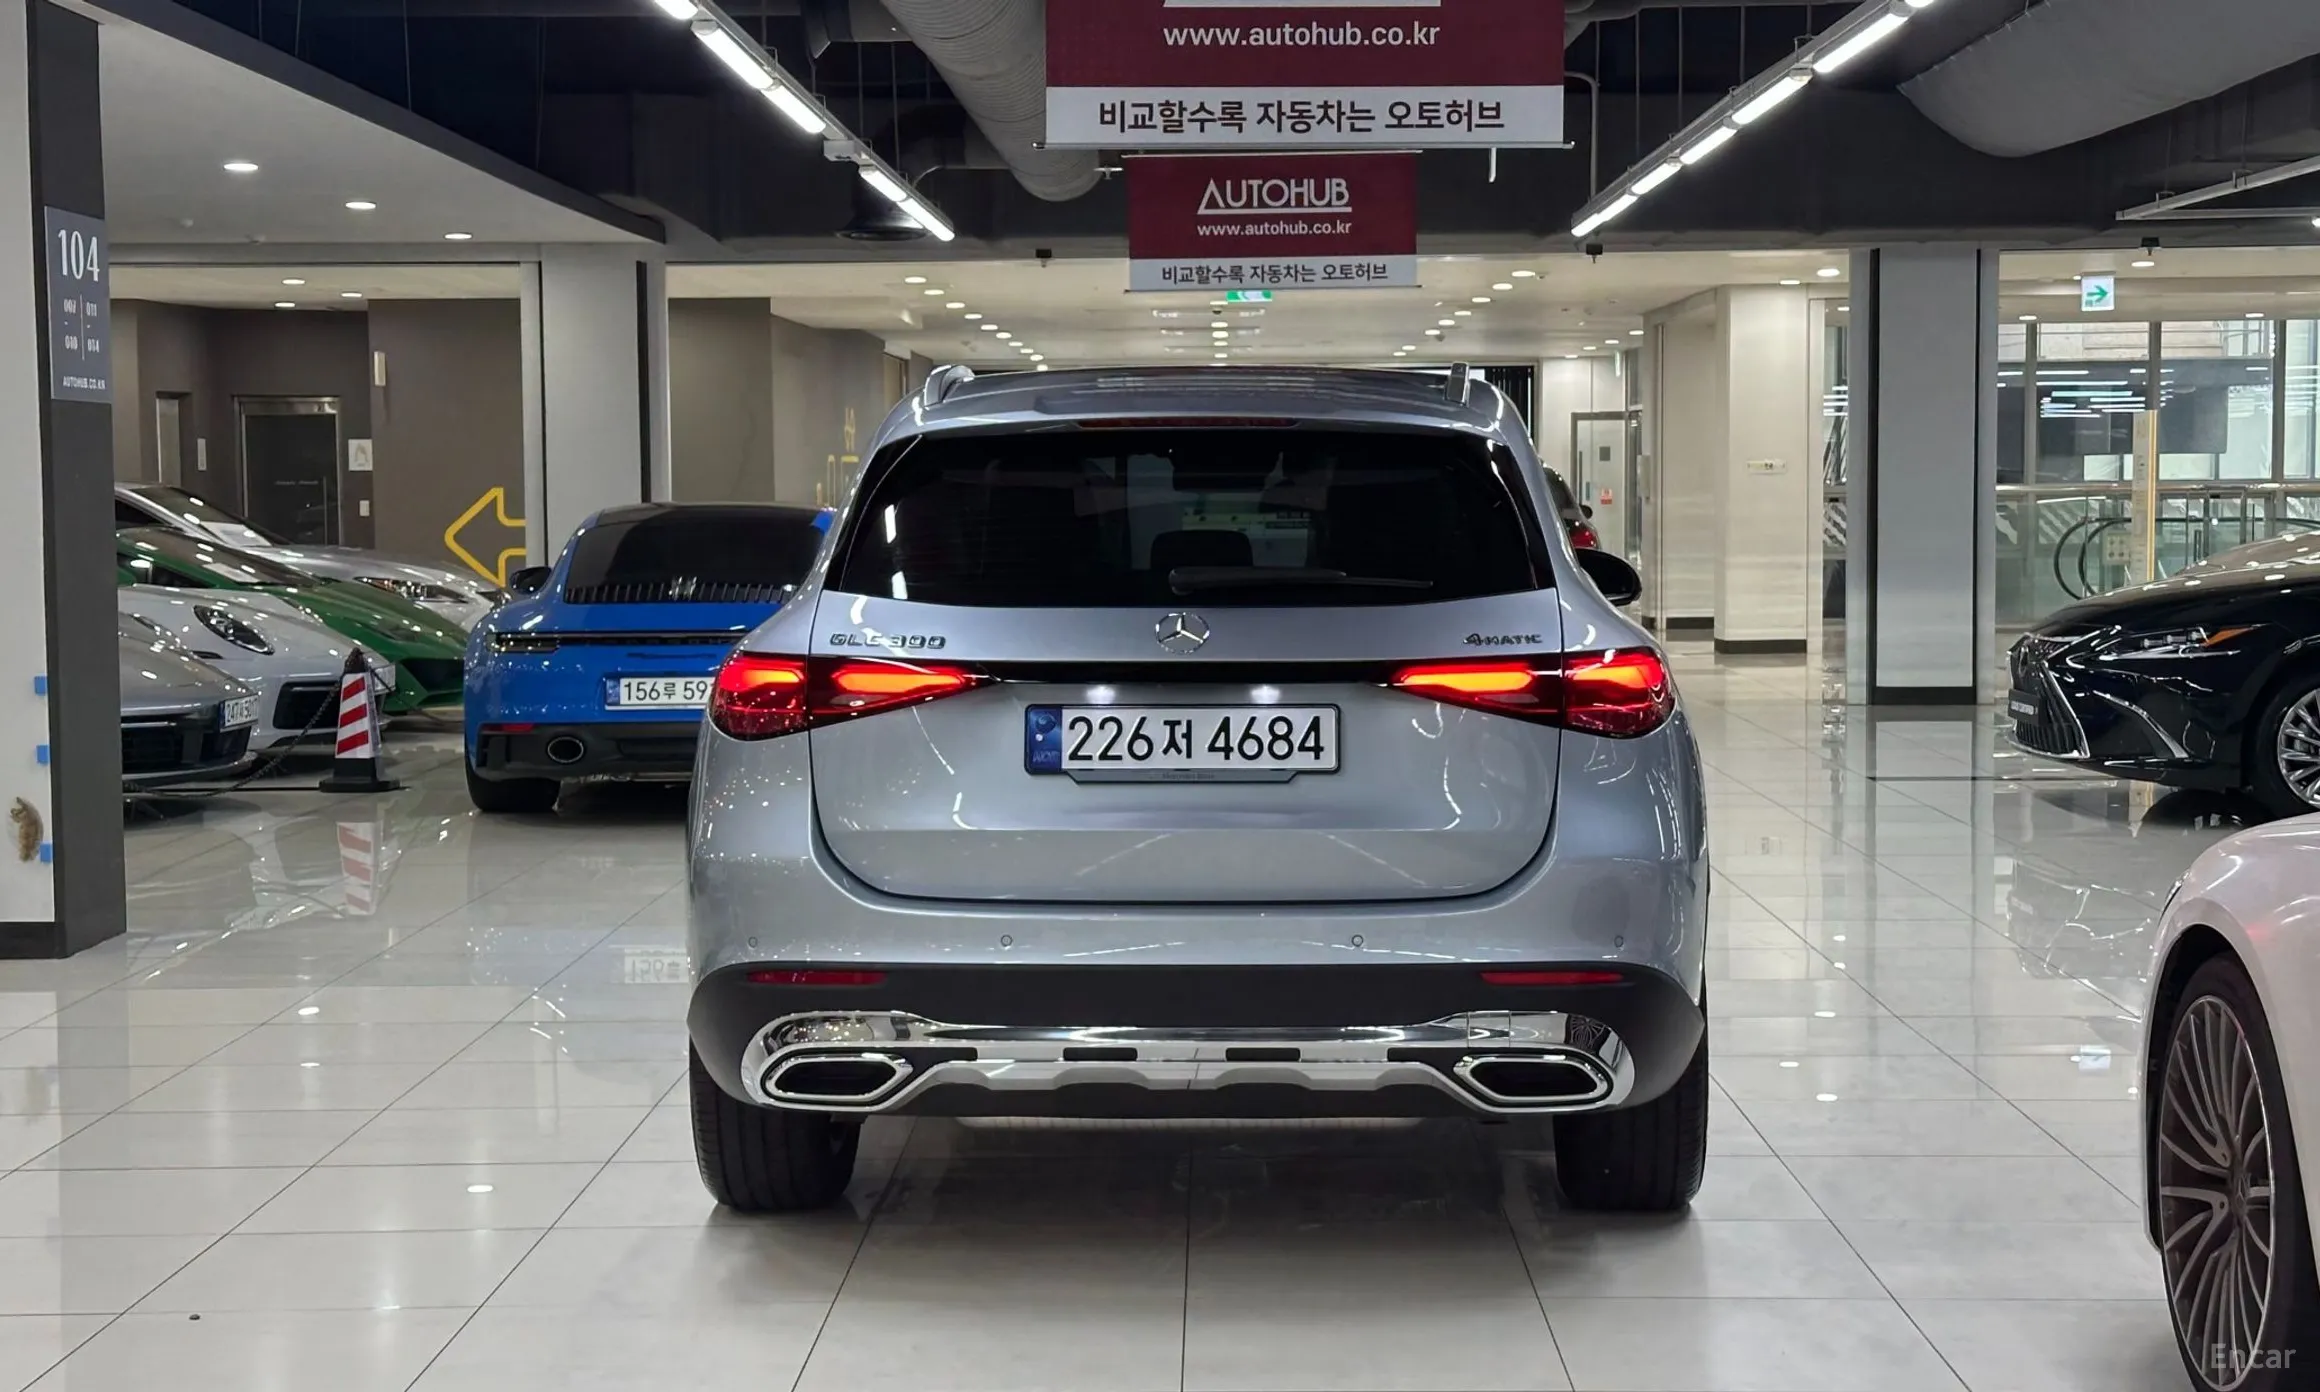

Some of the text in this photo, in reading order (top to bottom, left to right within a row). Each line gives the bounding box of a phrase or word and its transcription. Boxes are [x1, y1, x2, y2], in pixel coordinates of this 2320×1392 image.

[1163, 21, 1441, 46] www.autohub.co.kr
[1100, 100, 1504, 133] 비교할수록 자동차는 오토허브
[1197, 178, 1352, 215] AUTOHUB
[1197, 220, 1352, 236] www.autohub.co.kr
[58, 229, 100, 282] 104
[1162, 263, 1388, 285] 비교할수록 자동차는 오토허브
[623, 681, 714, 702] 156루 59
[1067, 716, 1325, 761] 226저 4684
